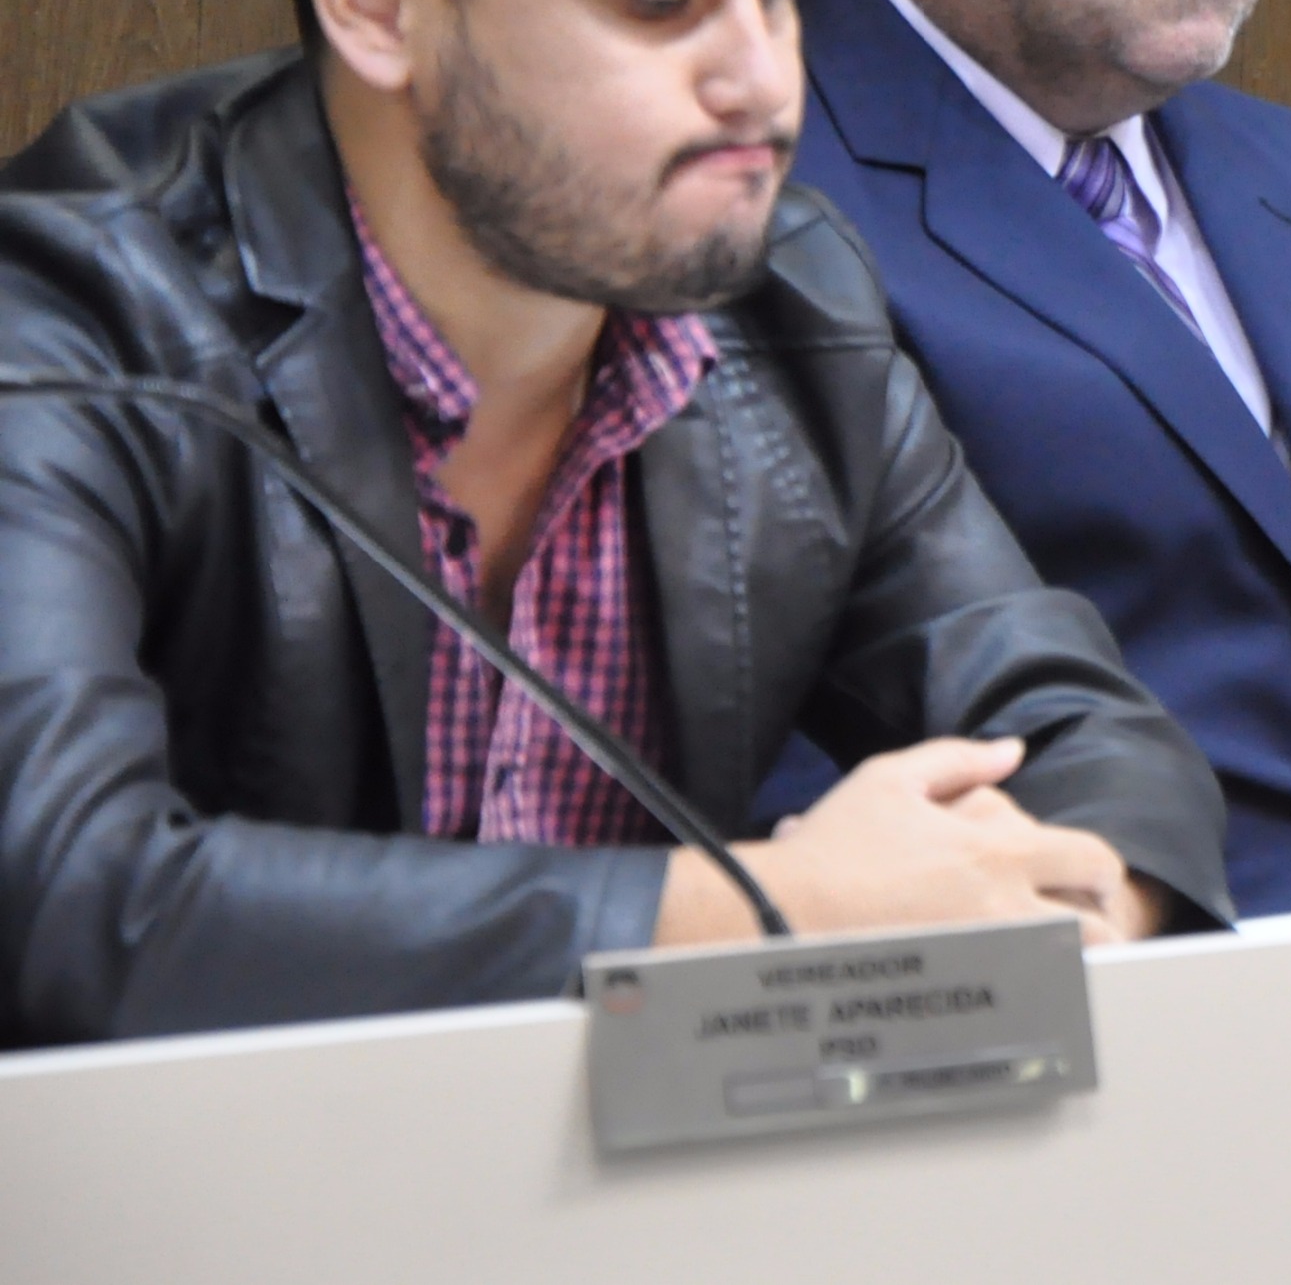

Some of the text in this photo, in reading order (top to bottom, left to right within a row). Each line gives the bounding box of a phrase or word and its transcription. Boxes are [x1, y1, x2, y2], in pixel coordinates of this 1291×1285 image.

[757, 953, 925, 988] VEREADOR
[696, 984, 994, 1039] JANETE APARECIDA
